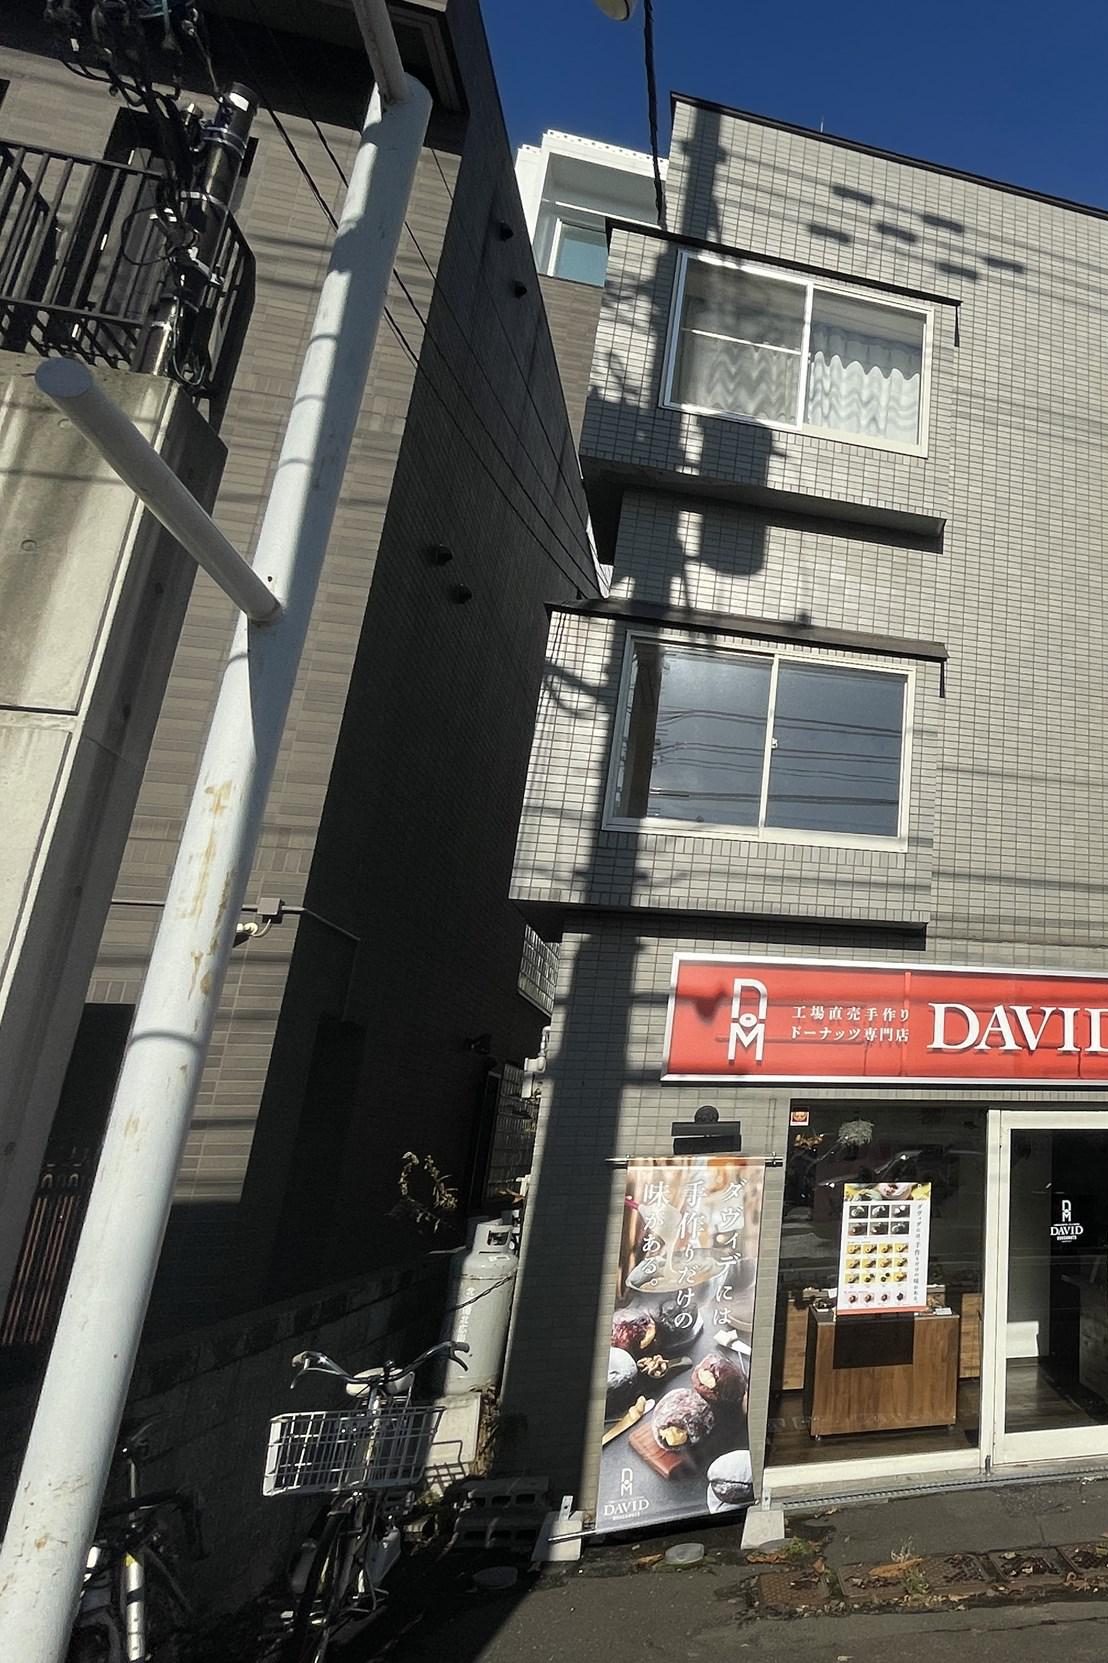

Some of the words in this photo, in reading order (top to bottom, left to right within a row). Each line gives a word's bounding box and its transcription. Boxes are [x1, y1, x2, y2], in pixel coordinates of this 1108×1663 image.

[791, 1005, 910, 1022] 工場直売手作り
[791, 1025, 910, 1042] ドーナッツ専門店
[1050, 1225, 1084, 1236] DAVID
[674, 1180, 708, 1329] 手作りだけの
[712, 1178, 749, 1326] ダヴィデには
[604, 1499, 650, 1517] DAVID
